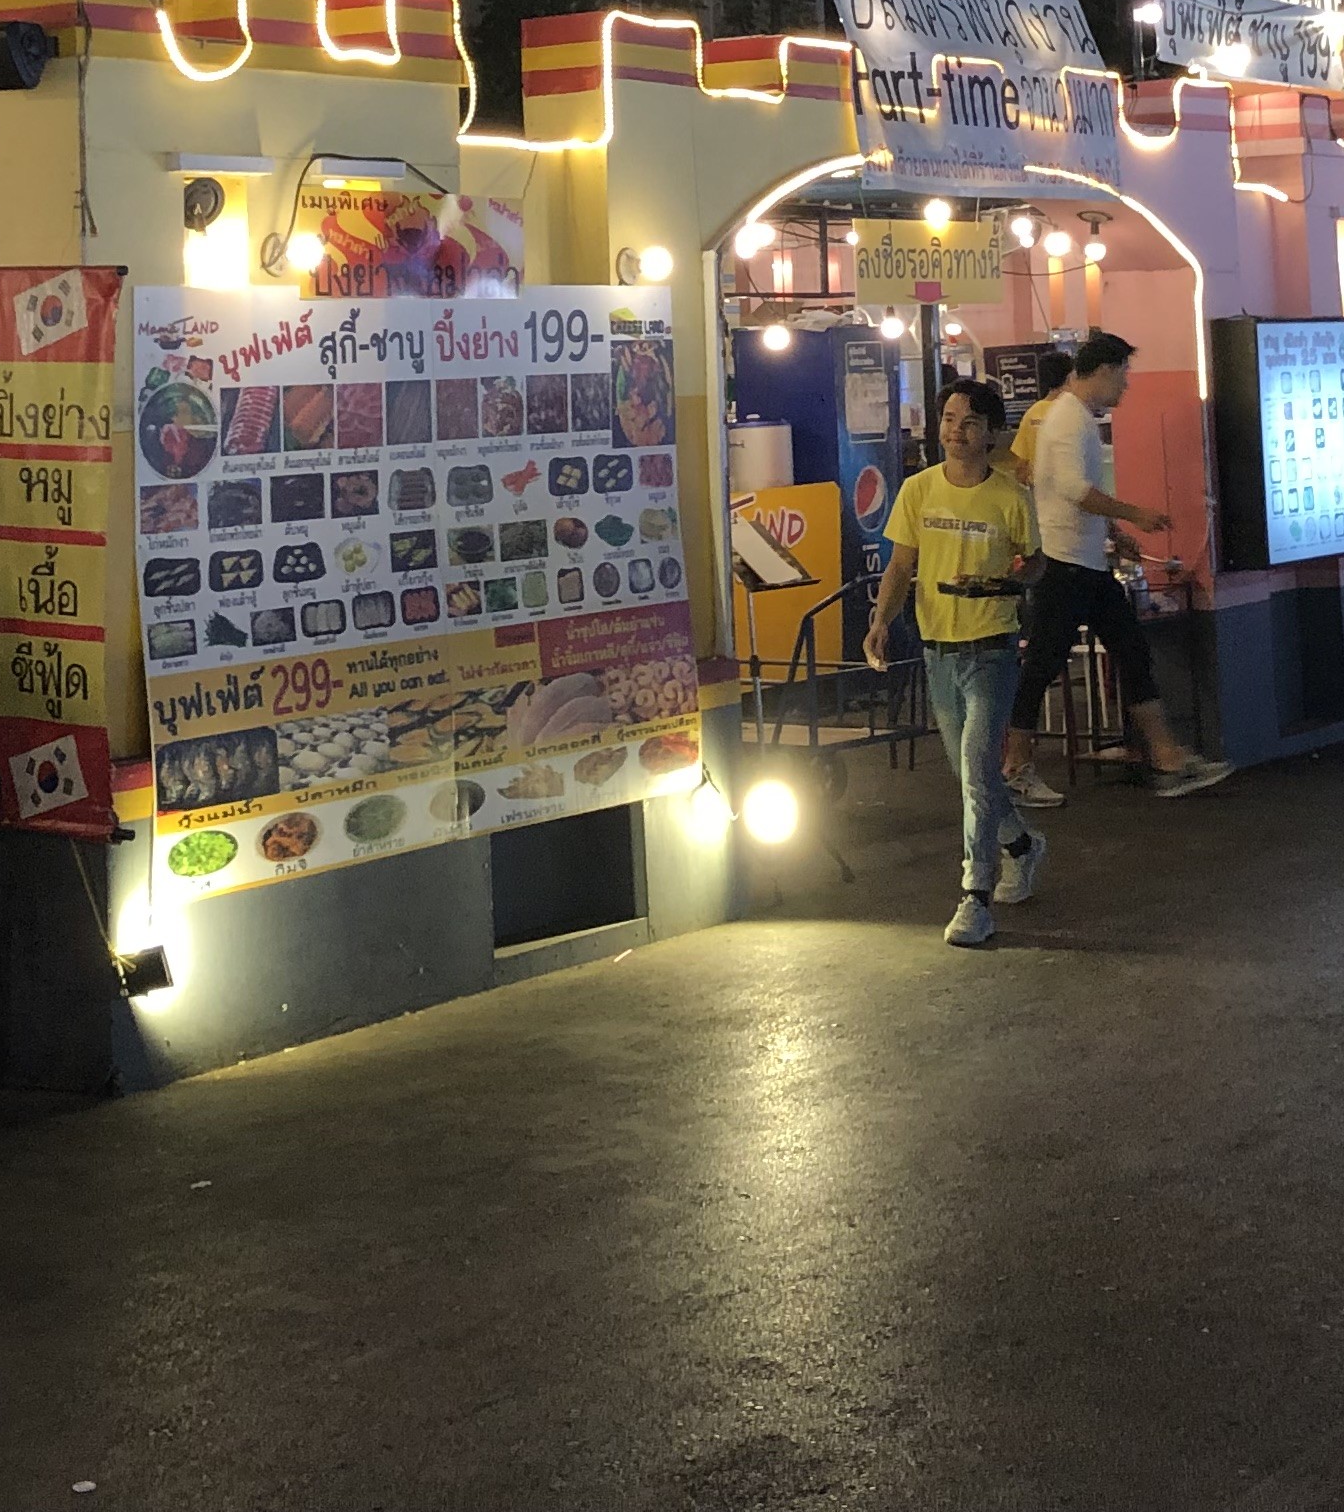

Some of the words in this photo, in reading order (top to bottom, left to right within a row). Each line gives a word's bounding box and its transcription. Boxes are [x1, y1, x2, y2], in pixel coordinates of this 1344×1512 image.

[857, 216, 1002, 280] ลงชื่อรอคิวทางนี้
[433, 307, 519, 362] ปิ้งย่าง
[524, 309, 604, 364] 199-
[19, 466, 73, 526] หมู
[18, 545, 78, 617] เนื้อ
[270, 657, 344, 716] 299-
